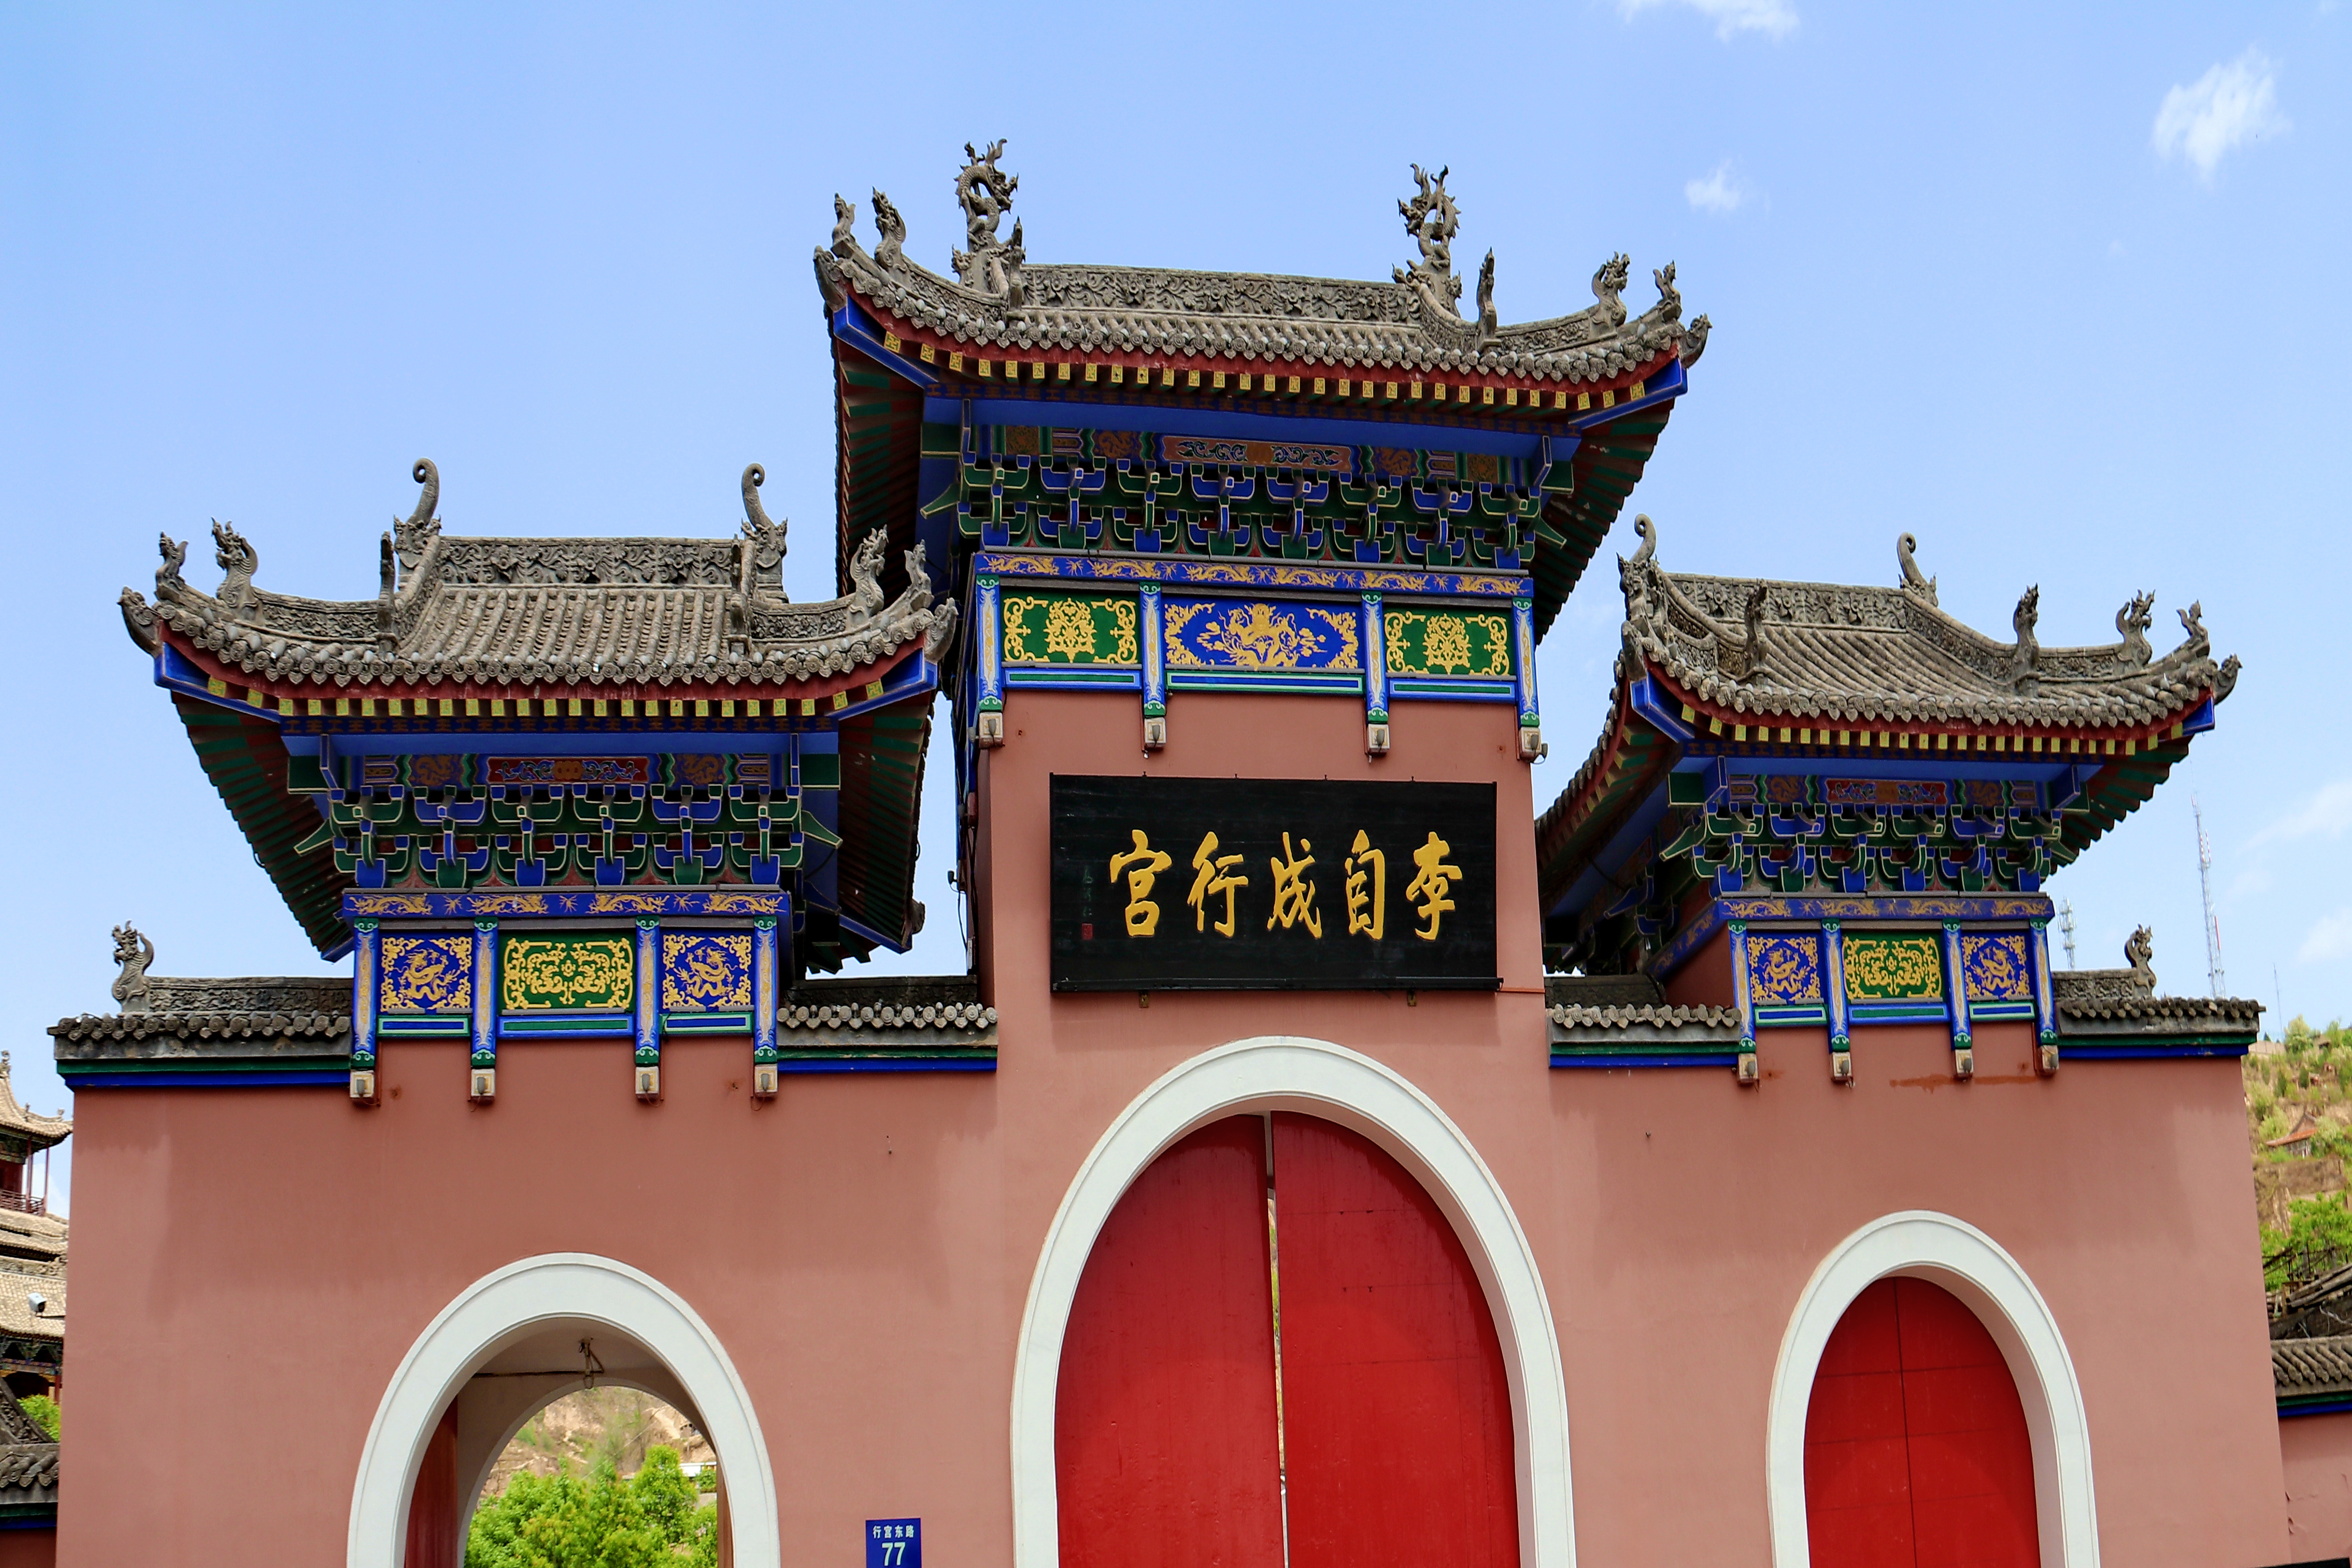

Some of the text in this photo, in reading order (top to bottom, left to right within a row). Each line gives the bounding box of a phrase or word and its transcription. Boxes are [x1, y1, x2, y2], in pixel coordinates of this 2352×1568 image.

[873, 1525, 914, 1539] 行宫东路
[882, 1542, 906, 1566] 77
